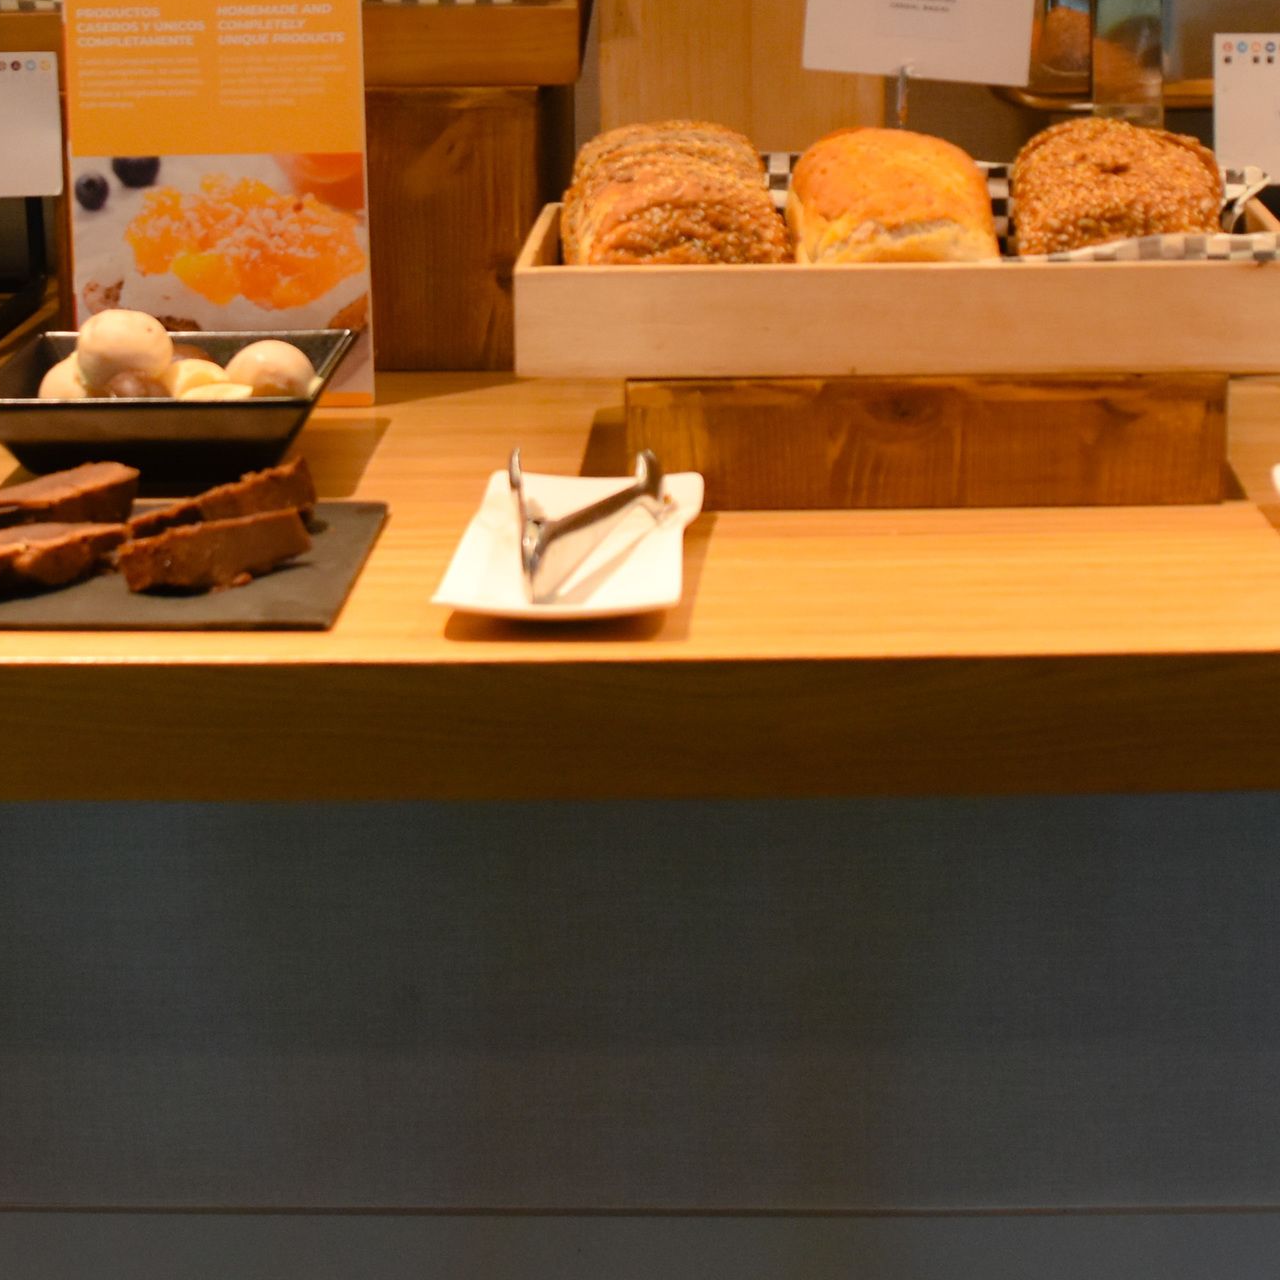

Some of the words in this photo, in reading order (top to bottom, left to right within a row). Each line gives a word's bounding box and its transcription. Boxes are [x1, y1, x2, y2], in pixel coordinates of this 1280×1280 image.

[75, 7, 161, 19] PRODUCTOS
[216, 4, 299, 16] HOMEMADE
[302, 3, 333, 15] AND
[76, 21, 139, 33] CASEROS
[142, 21, 152, 32] Y
[217, 19, 306, 30] COMPLETELY
[77, 35, 195, 48] COMPLETAMENTE
[217, 33, 269, 46] UNIQUE
[272, 31, 346, 44] PRODUCTS
